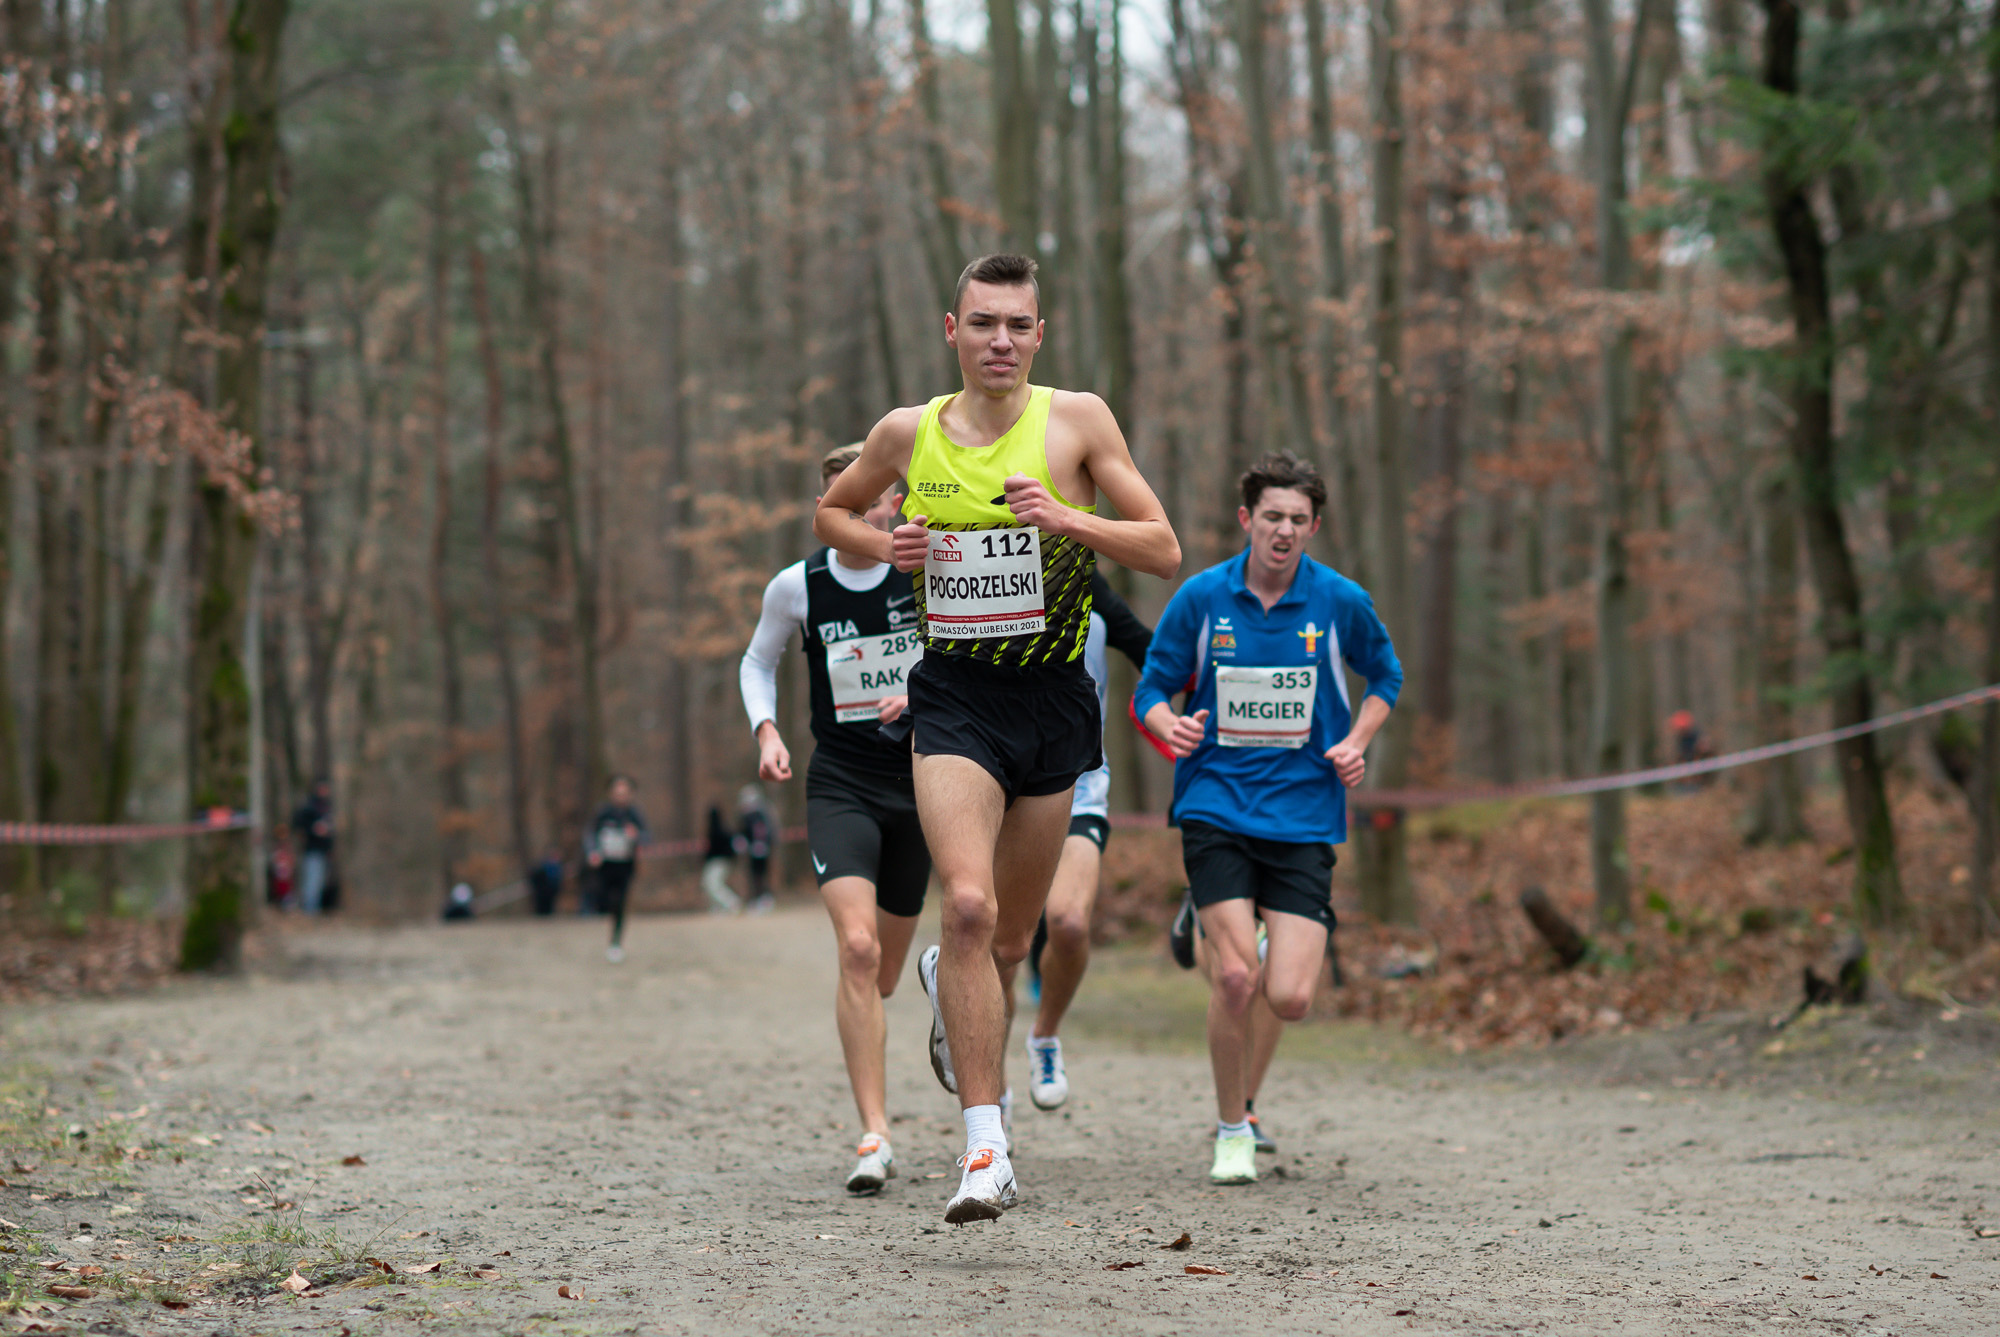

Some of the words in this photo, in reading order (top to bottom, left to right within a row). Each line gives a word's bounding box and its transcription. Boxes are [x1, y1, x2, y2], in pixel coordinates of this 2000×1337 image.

[917, 482, 960, 493] BEASTS
[981, 532, 1032, 558] 112
[934, 551, 960, 561] ORLEN
[930, 572, 1038, 600] POGORZELSKI
[933, 624, 977, 635] TOMASZÓW
[979, 623, 1018, 634] LUBELSKI
[1020, 620, 1040, 631] 2021
[881, 632, 918, 657] 289
[860, 666, 904, 690] RAK
[1272, 671, 1311, 689] 353
[1229, 701, 1305, 719] MEGIER
